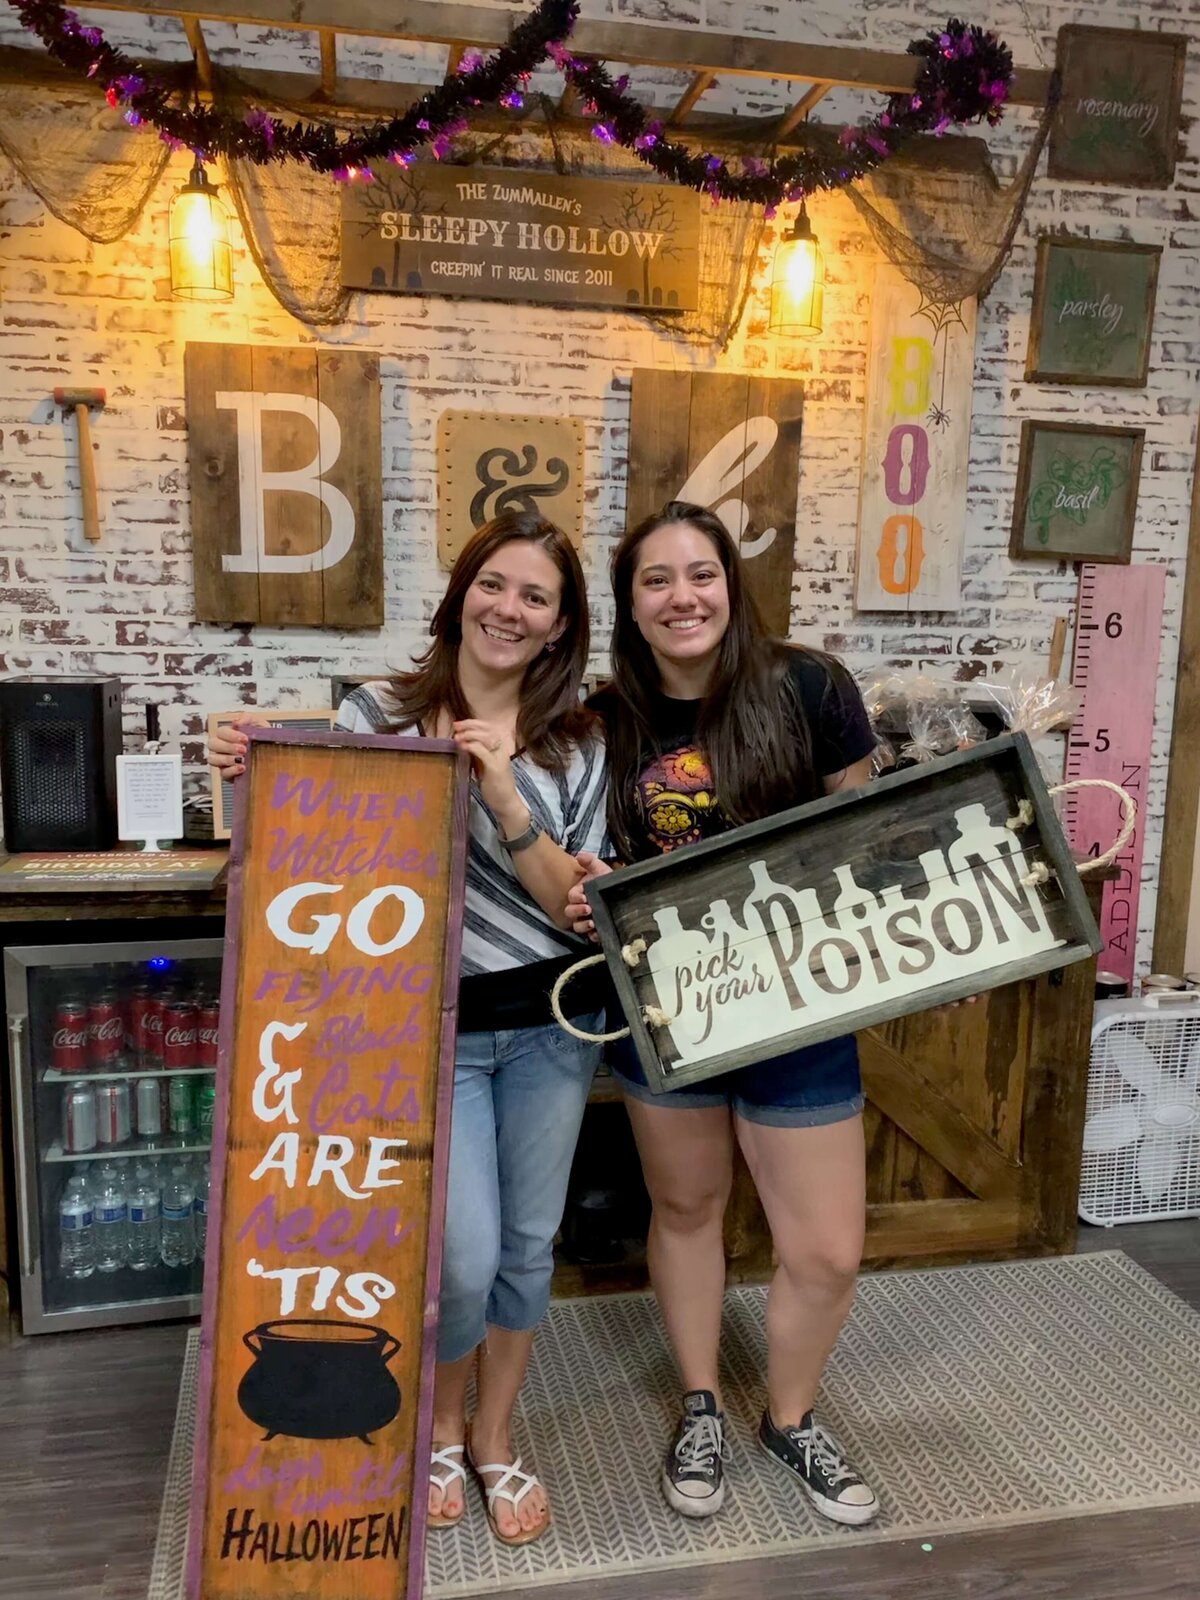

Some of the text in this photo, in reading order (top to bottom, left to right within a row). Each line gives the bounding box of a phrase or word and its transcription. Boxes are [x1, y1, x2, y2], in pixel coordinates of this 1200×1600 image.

[1076, 98, 1159, 138] rosemary
[456, 183, 487, 201] THE
[380, 211, 664, 259] SLEEPY HOLLOW
[430, 260, 613, 286] CREEPIN' IT REAL SINCE 2011
[1058, 293, 1124, 336] parsley
[215, 391, 356, 574] B
[876, 336, 935, 595] BOO
[1054, 485, 1100, 509] basil
[1103, 612, 1123, 638] 6
[1094, 728, 1110, 752] 5
[270, 772, 425, 821] WHEN
[23, 861, 159, 869] BIRTHDAY
[267, 826, 440, 879] Witches
[266, 882, 425, 957] GO
[253, 962, 433, 1013] FLYING
[674, 929, 744, 1018] pick
[691, 963, 774, 1046] your
[312, 1004, 422, 1060] Black
[252, 1021, 308, 1124] &
[308, 1060, 420, 1133] Cats
[249, 1132, 408, 1200] ARE
[235, 1193, 418, 1257] seen
[220, 1506, 406, 1565] HALLOWEEN
